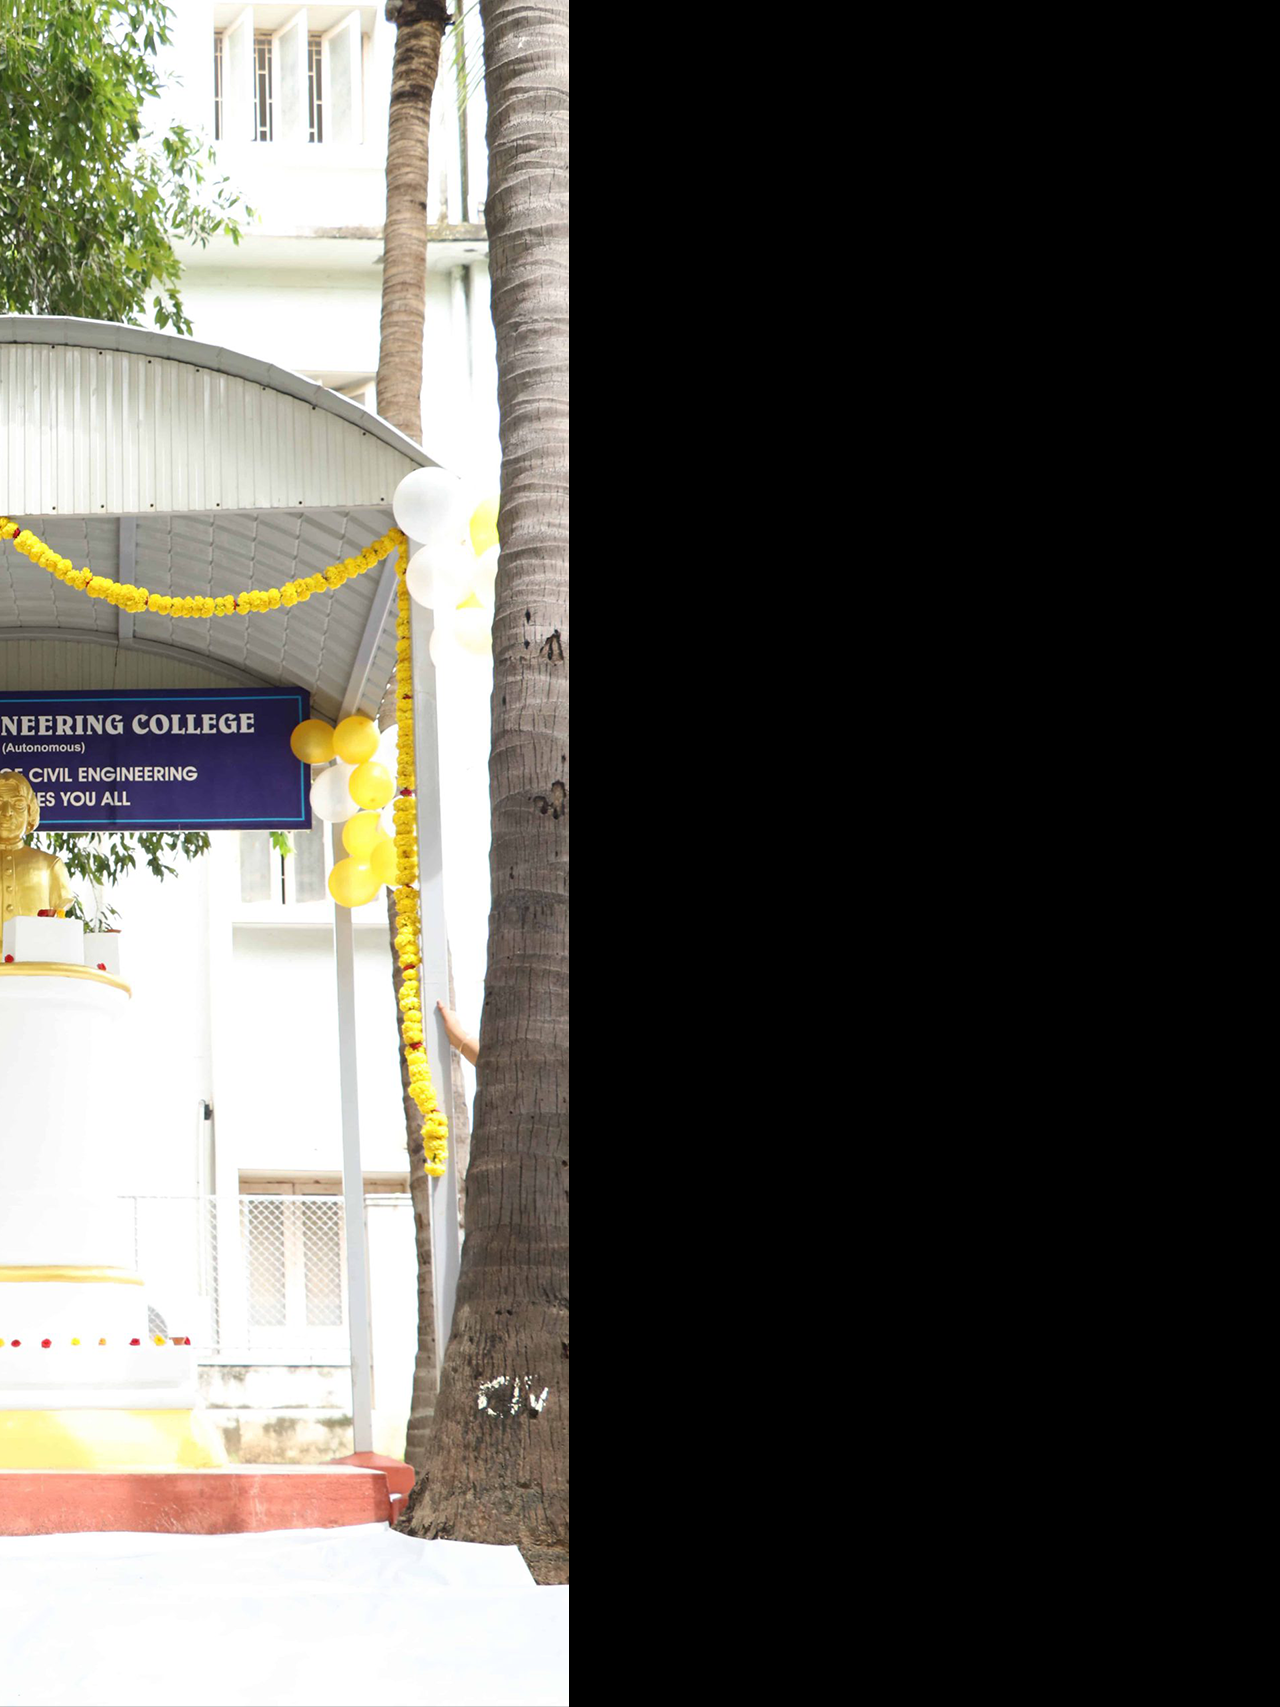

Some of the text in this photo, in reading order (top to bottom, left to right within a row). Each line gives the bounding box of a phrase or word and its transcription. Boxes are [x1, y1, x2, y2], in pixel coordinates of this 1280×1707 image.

[132, 713, 256, 735] COLLEGE
[2, 742, 86, 755] (Autonomous)
[28, 767, 73, 783] CIVIL
[78, 766, 198, 782] ENGINEERING
[59, 791, 96, 807] YOU
[100, 790, 131, 806] ALL
